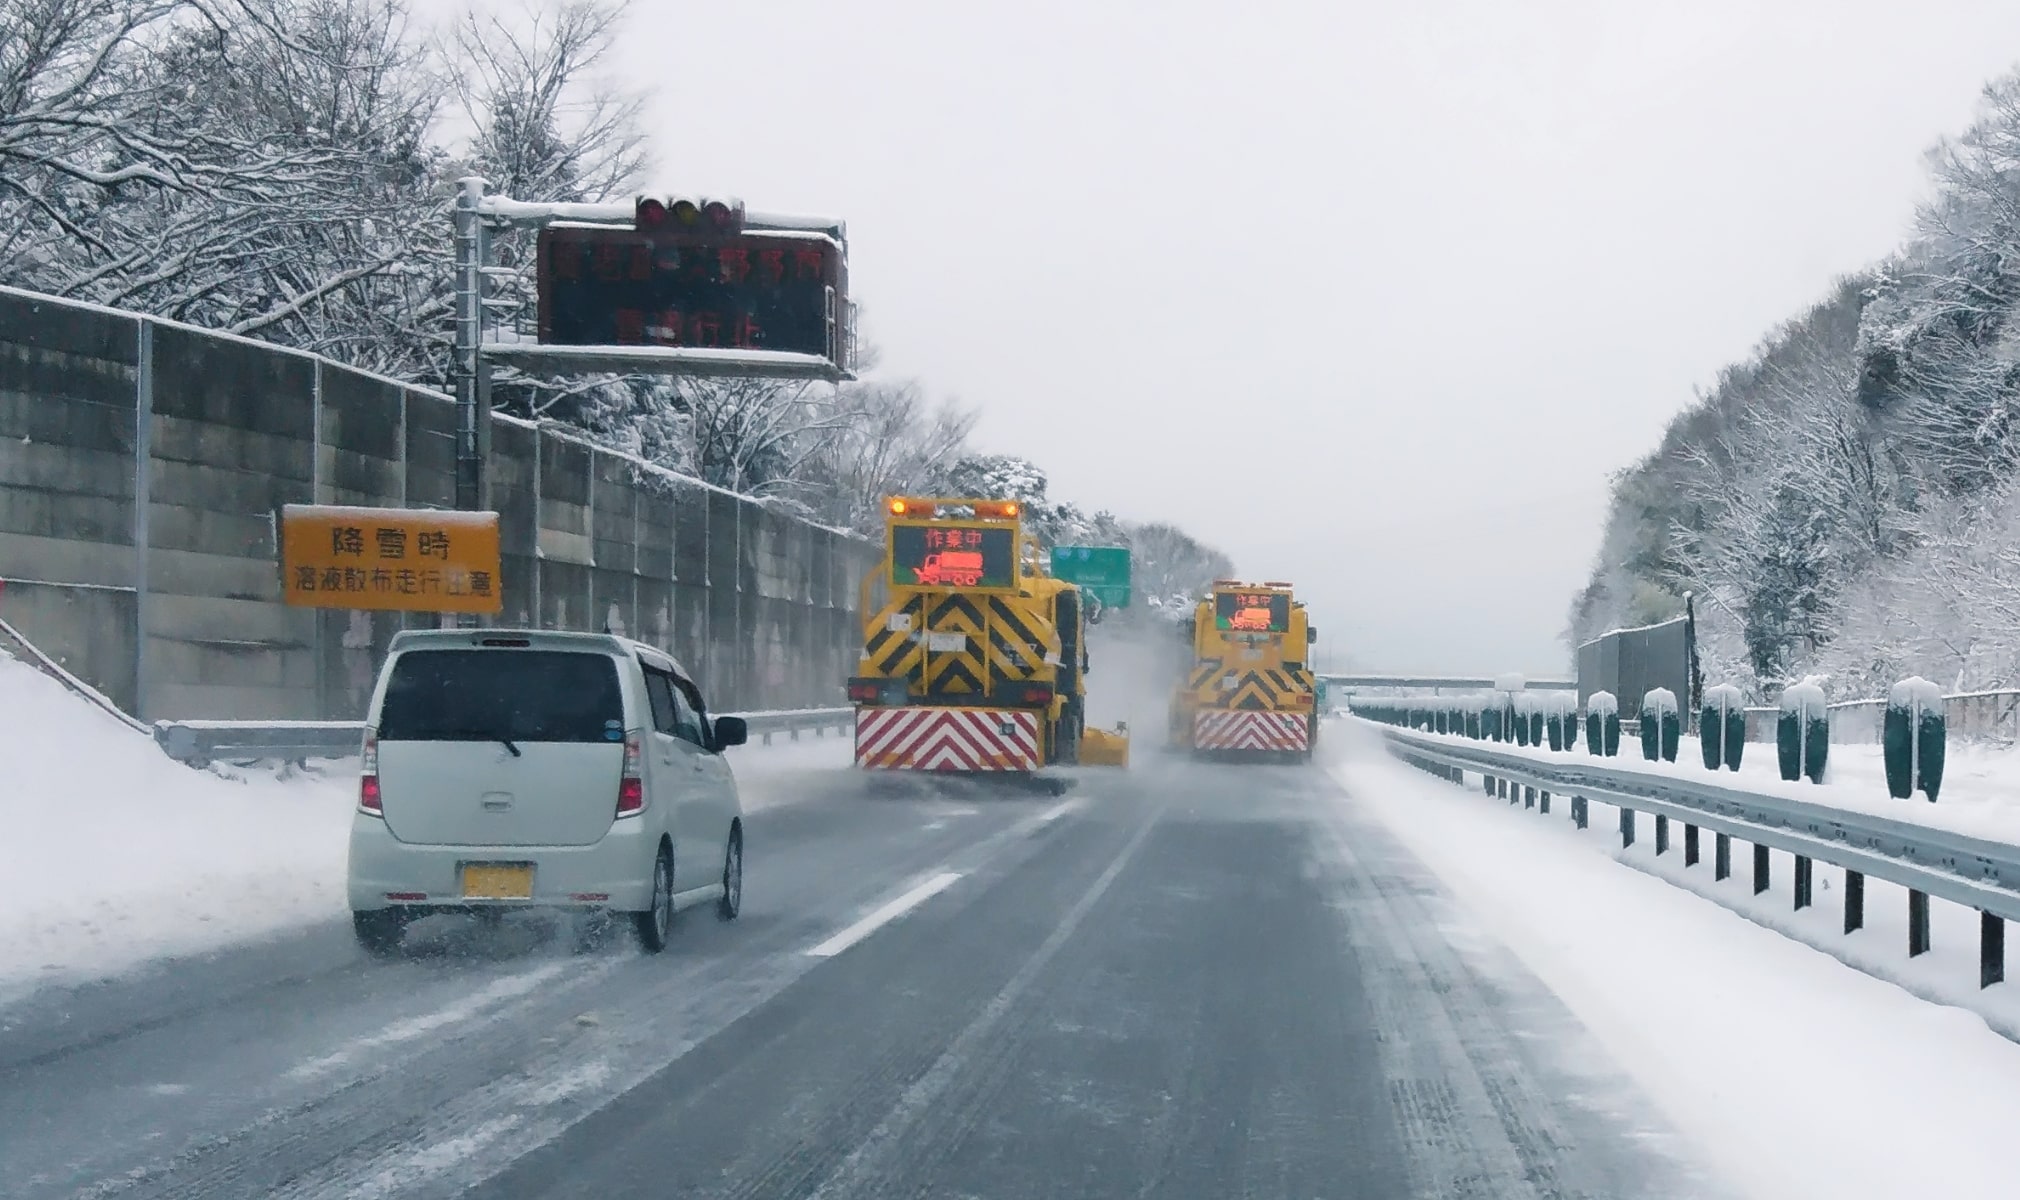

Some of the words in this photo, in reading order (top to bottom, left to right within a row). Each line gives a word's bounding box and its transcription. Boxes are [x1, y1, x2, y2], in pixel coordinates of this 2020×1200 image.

[332, 526, 450, 560] 降雪時
[925, 528, 982, 549] 作業中
